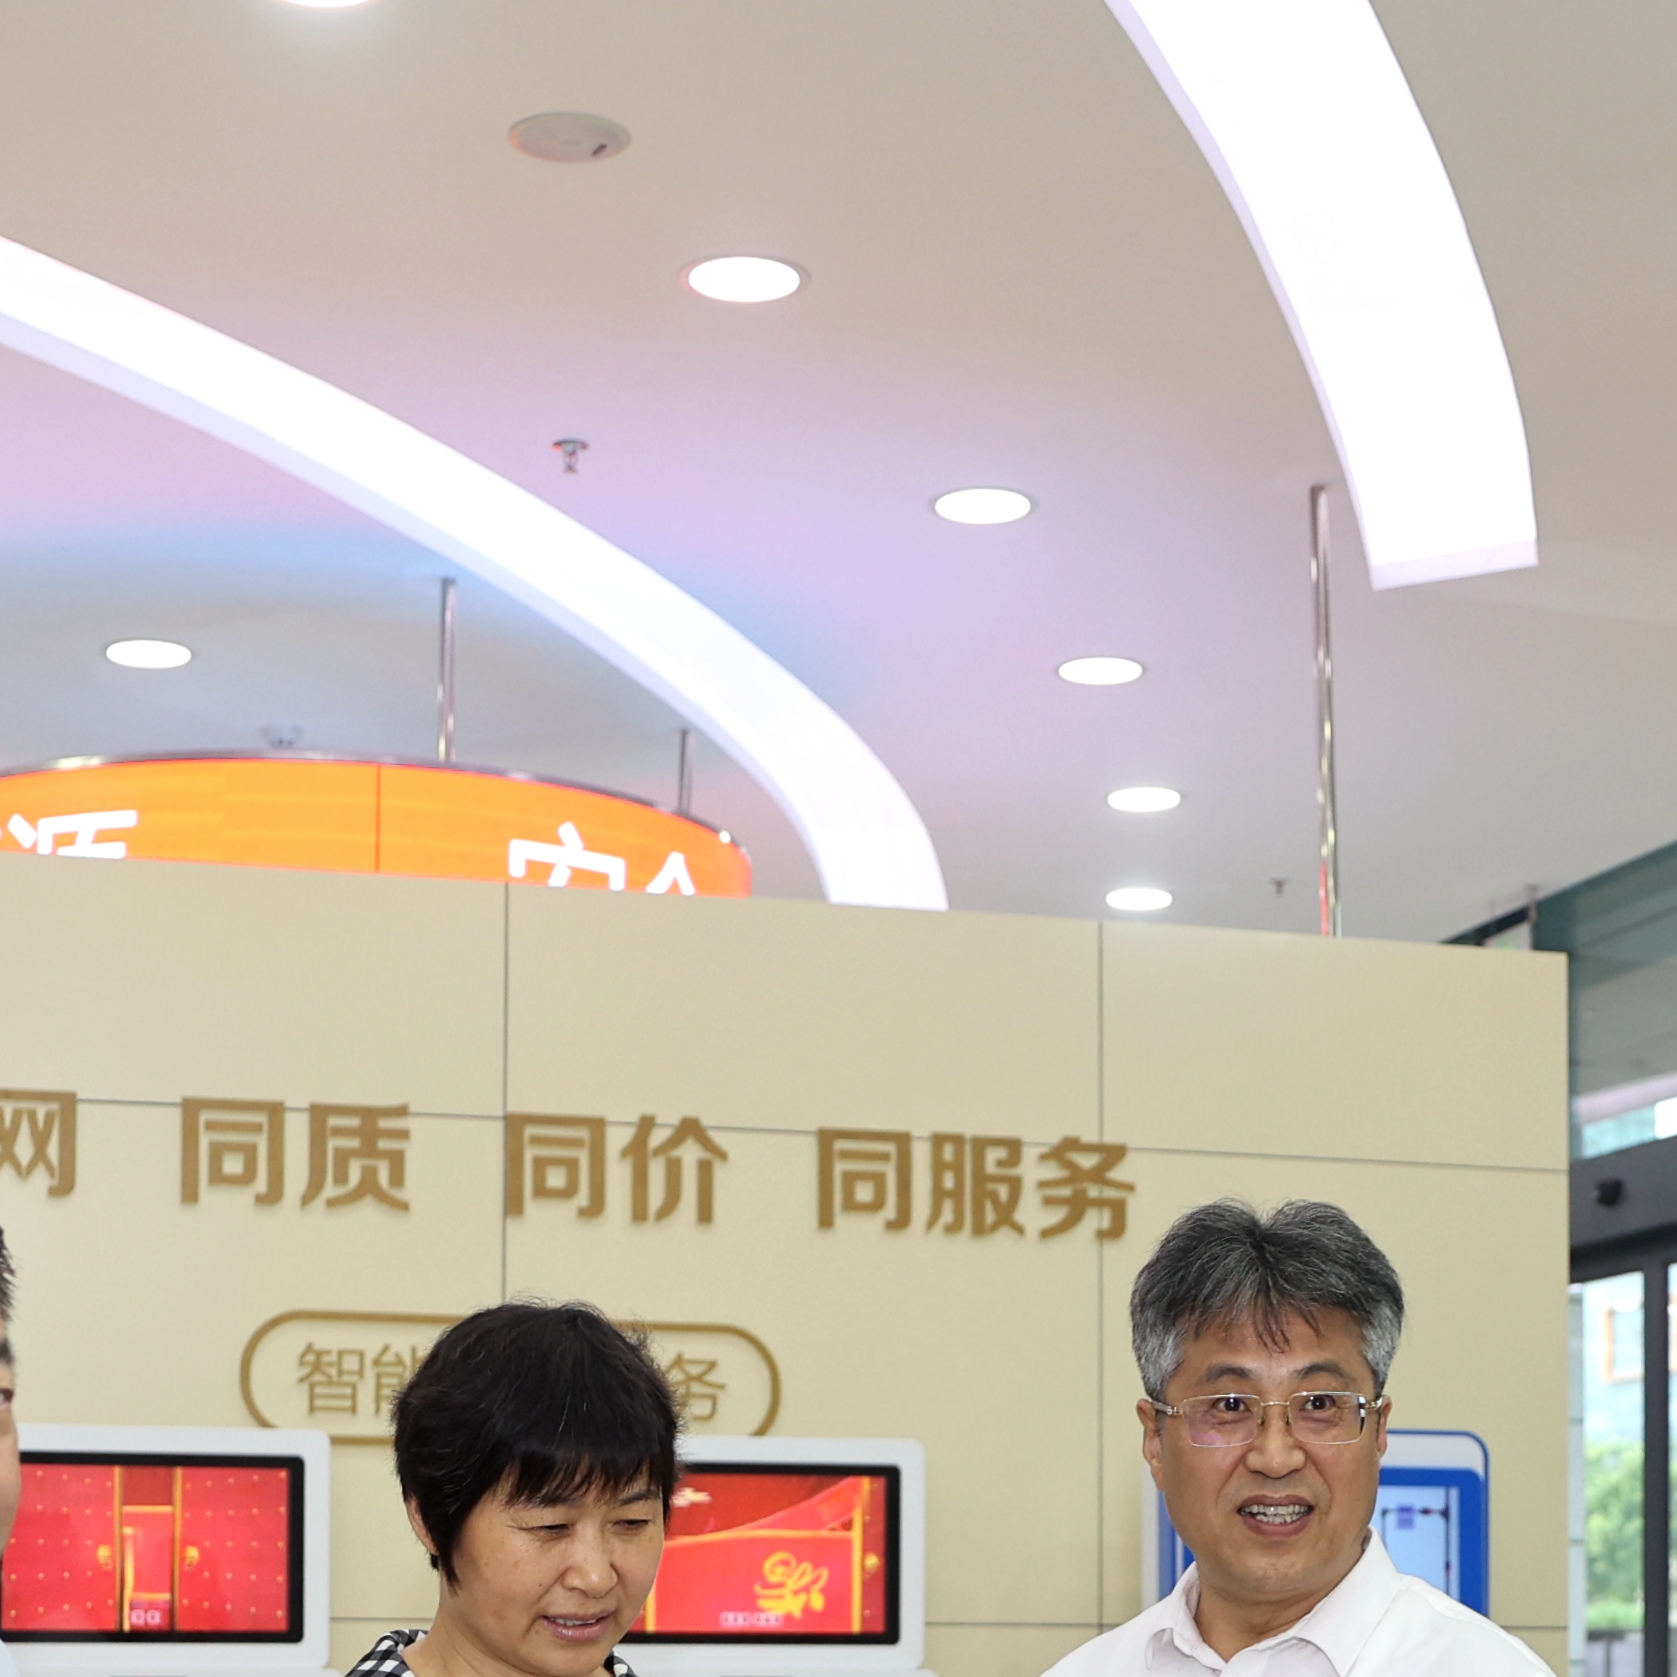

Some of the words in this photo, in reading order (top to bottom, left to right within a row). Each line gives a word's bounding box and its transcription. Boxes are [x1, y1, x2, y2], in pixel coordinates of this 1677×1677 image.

[180, 1095, 413, 1213] 同质
[504, 1109, 729, 1226] 同价
[816, 1127, 1137, 1241] 同服务
